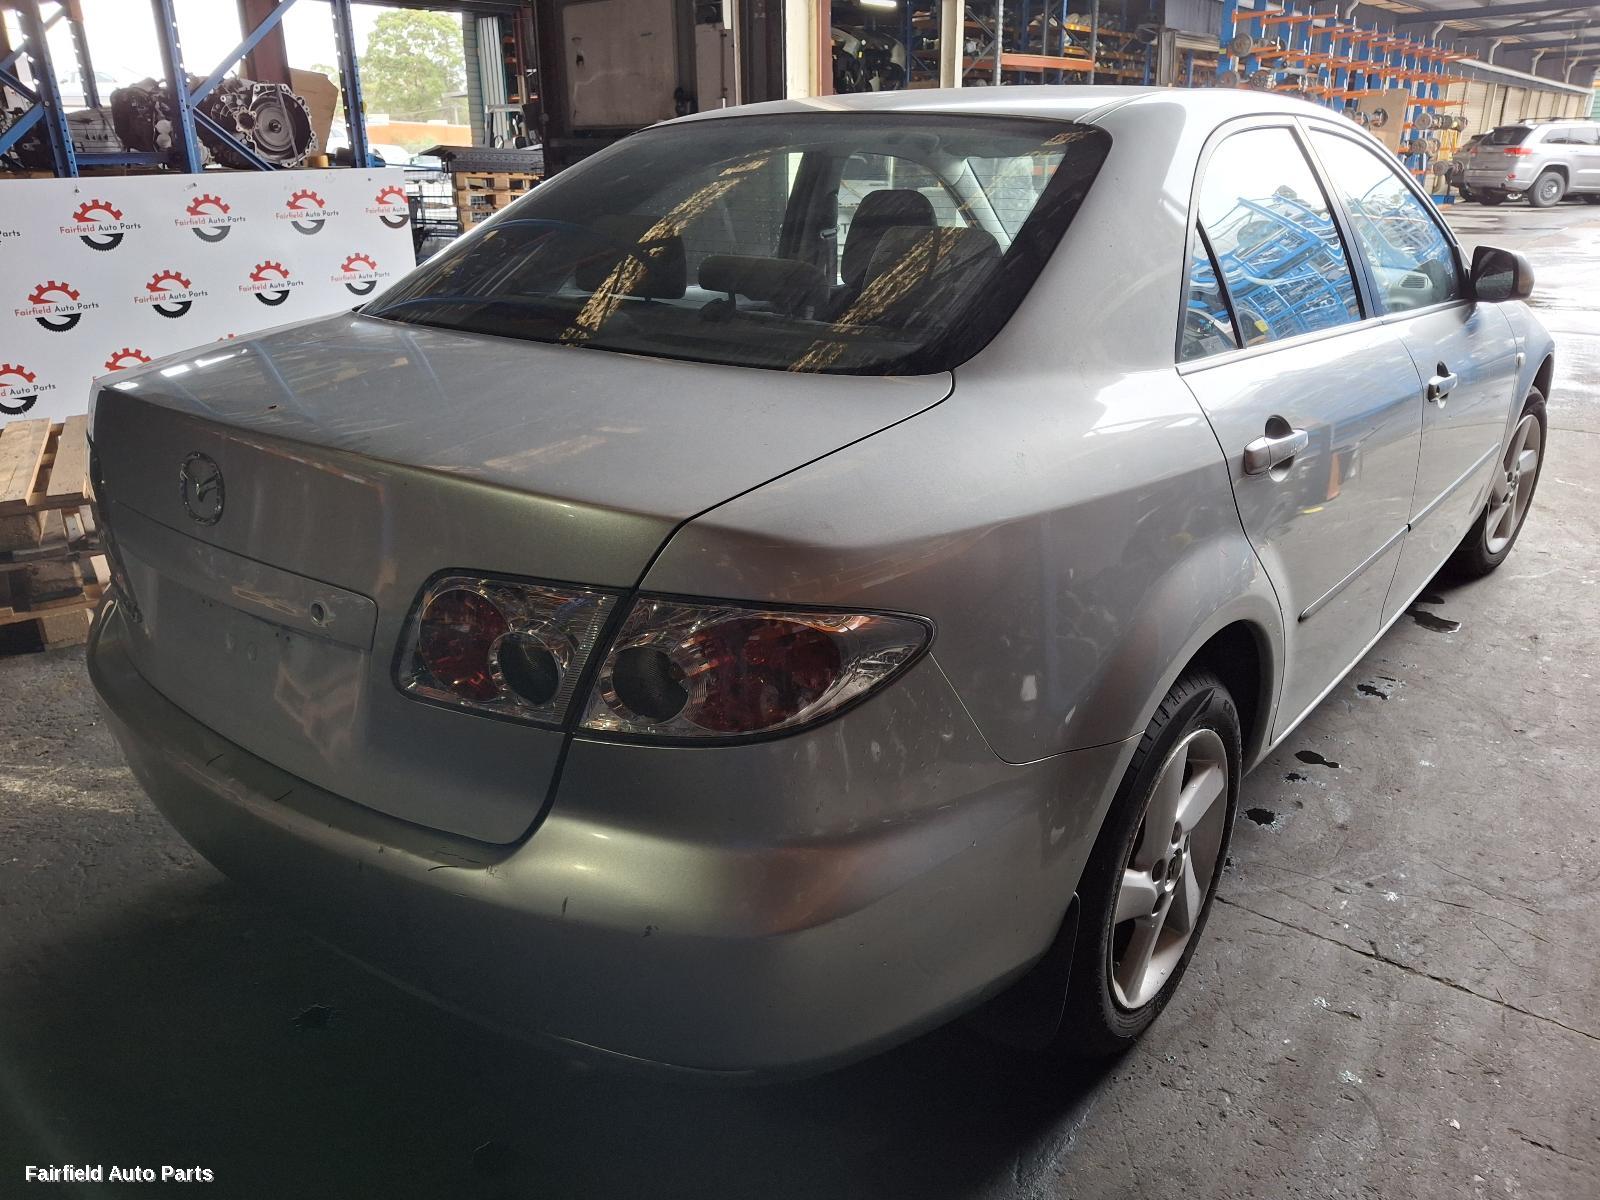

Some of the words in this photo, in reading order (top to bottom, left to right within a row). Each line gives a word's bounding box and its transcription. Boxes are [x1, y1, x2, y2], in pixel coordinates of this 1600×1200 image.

[275, 211, 303, 220] Fairfield
[322, 209, 339, 217] Parts
[174, 217, 206, 227] Fairfield
[208, 216, 225, 224] Auto
[227, 215, 246, 223] Parts
[60, 225, 95, 235] Fairfield
[98, 223, 117, 231] Auto
[120, 222, 141, 231] Parts
[330, 273, 356, 282] Fairfield
[238, 283, 267, 292] Fairfield
[134, 293, 167, 304] Fairfield
[168, 292, 187, 300] Auto
[188, 290, 208, 298] Parts
[14, 306, 52, 317] Fairfield
[54, 305, 75, 313] Auto
[77, 302, 100, 310] Parts
[10, 388, 31, 396] Auto
[33, 383, 57, 392] Parts
